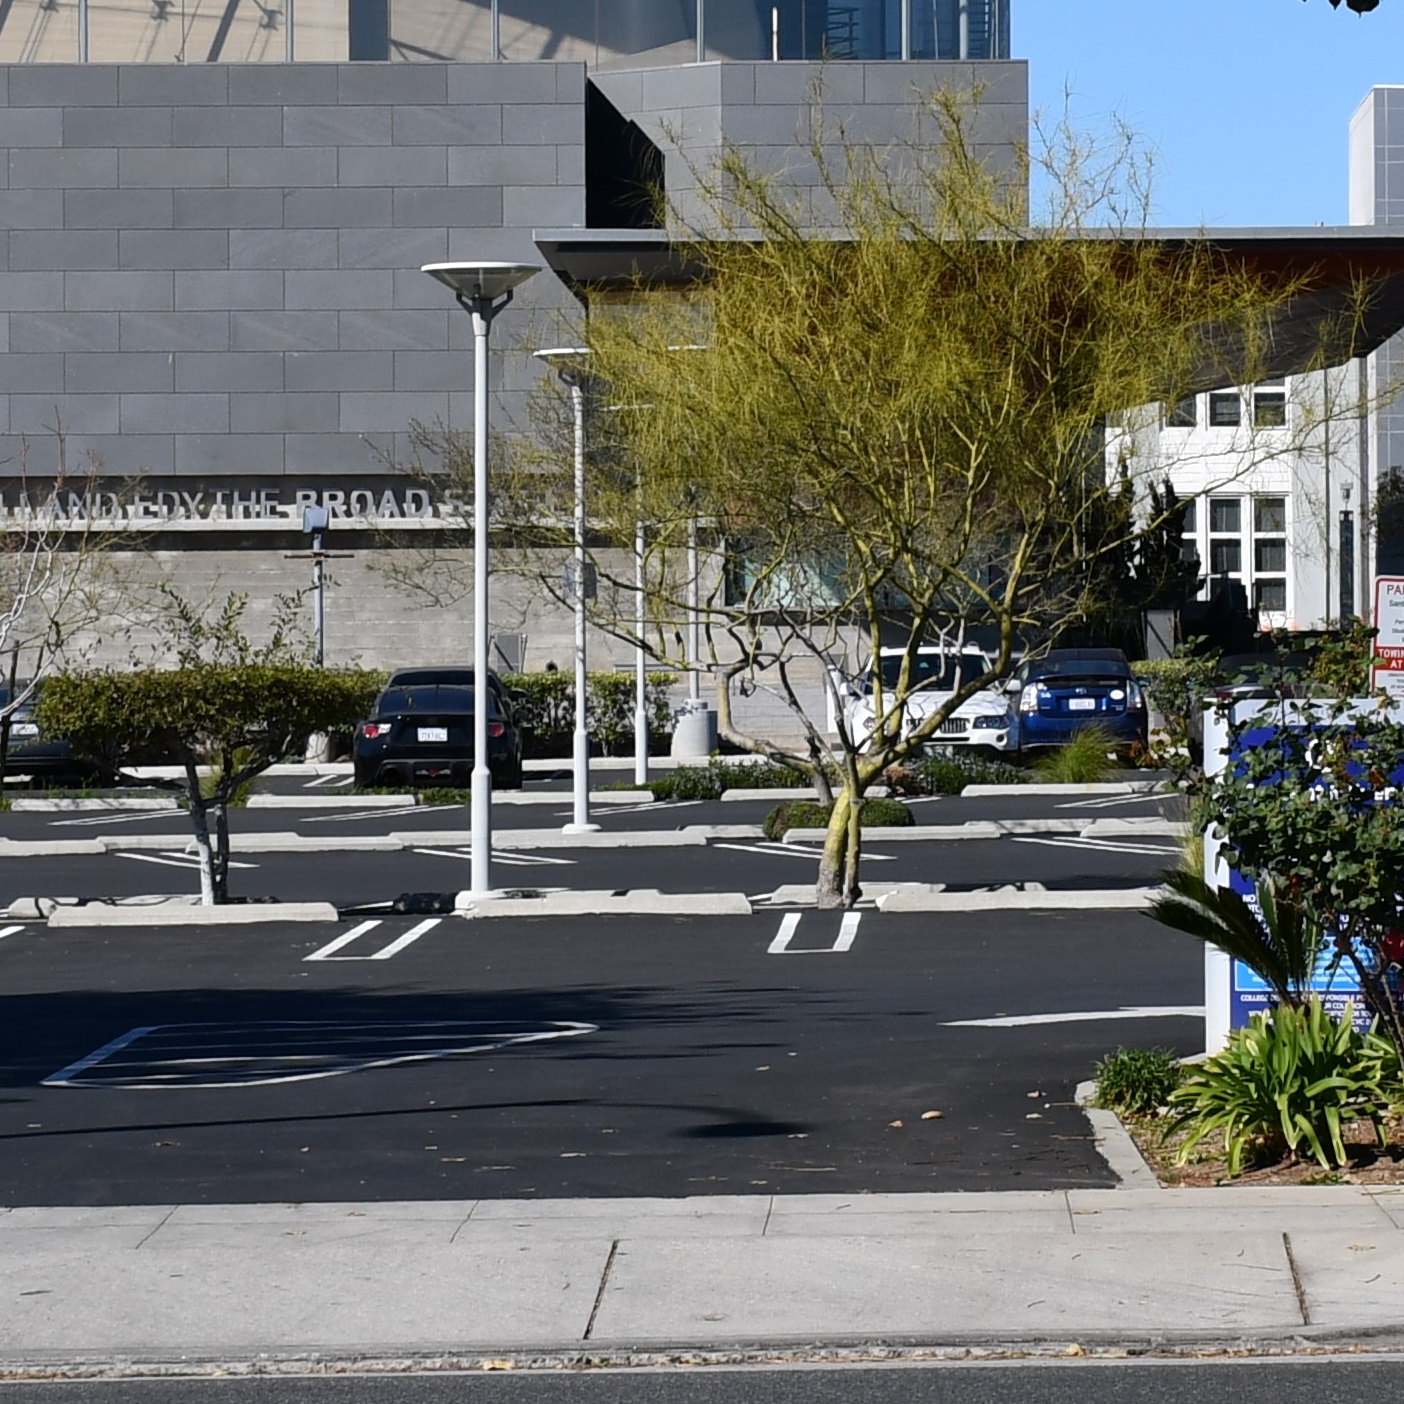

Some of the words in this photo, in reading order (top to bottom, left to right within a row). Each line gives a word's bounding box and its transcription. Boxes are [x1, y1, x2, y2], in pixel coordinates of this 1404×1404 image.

[36, 492, 120, 521] AND
[135, 490, 281, 520] EDYTHE
[297, 488, 430, 520] BROAD
[1390, 660, 1402, 668] AT
